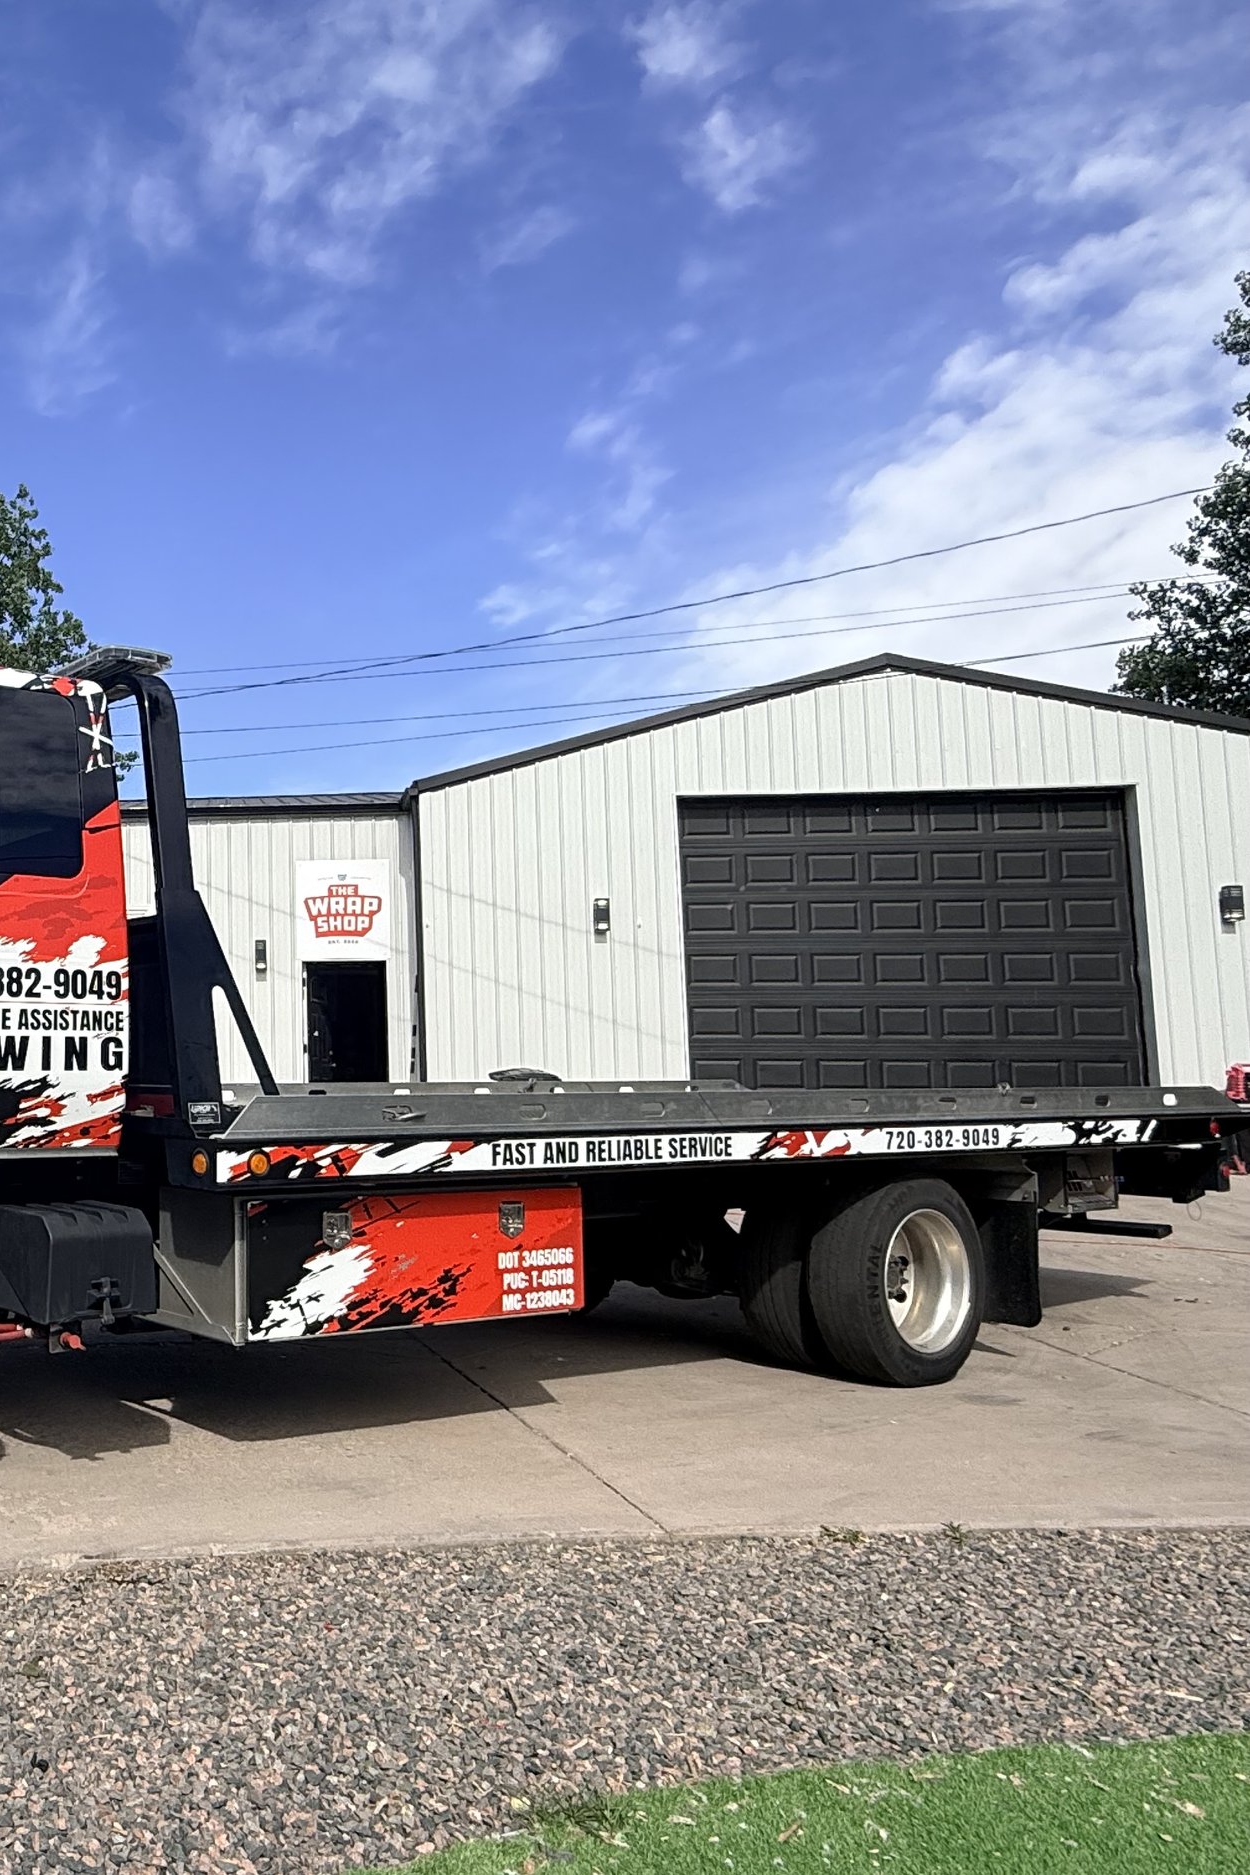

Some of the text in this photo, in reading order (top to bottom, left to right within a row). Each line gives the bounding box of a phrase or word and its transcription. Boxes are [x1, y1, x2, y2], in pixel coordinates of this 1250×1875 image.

[330, 886, 356, 896] THE
[307, 896, 380, 916] WRAP
[316, 915, 370, 932] SHOP
[17, 1008, 124, 1032] ASSISTANCE
[885, 1127, 1000, 1150] 720-382-9049
[491, 1136, 733, 1166] FAST AND RELIABLE SERVICE
[497, 1247, 575, 1270] DOT 3465066
